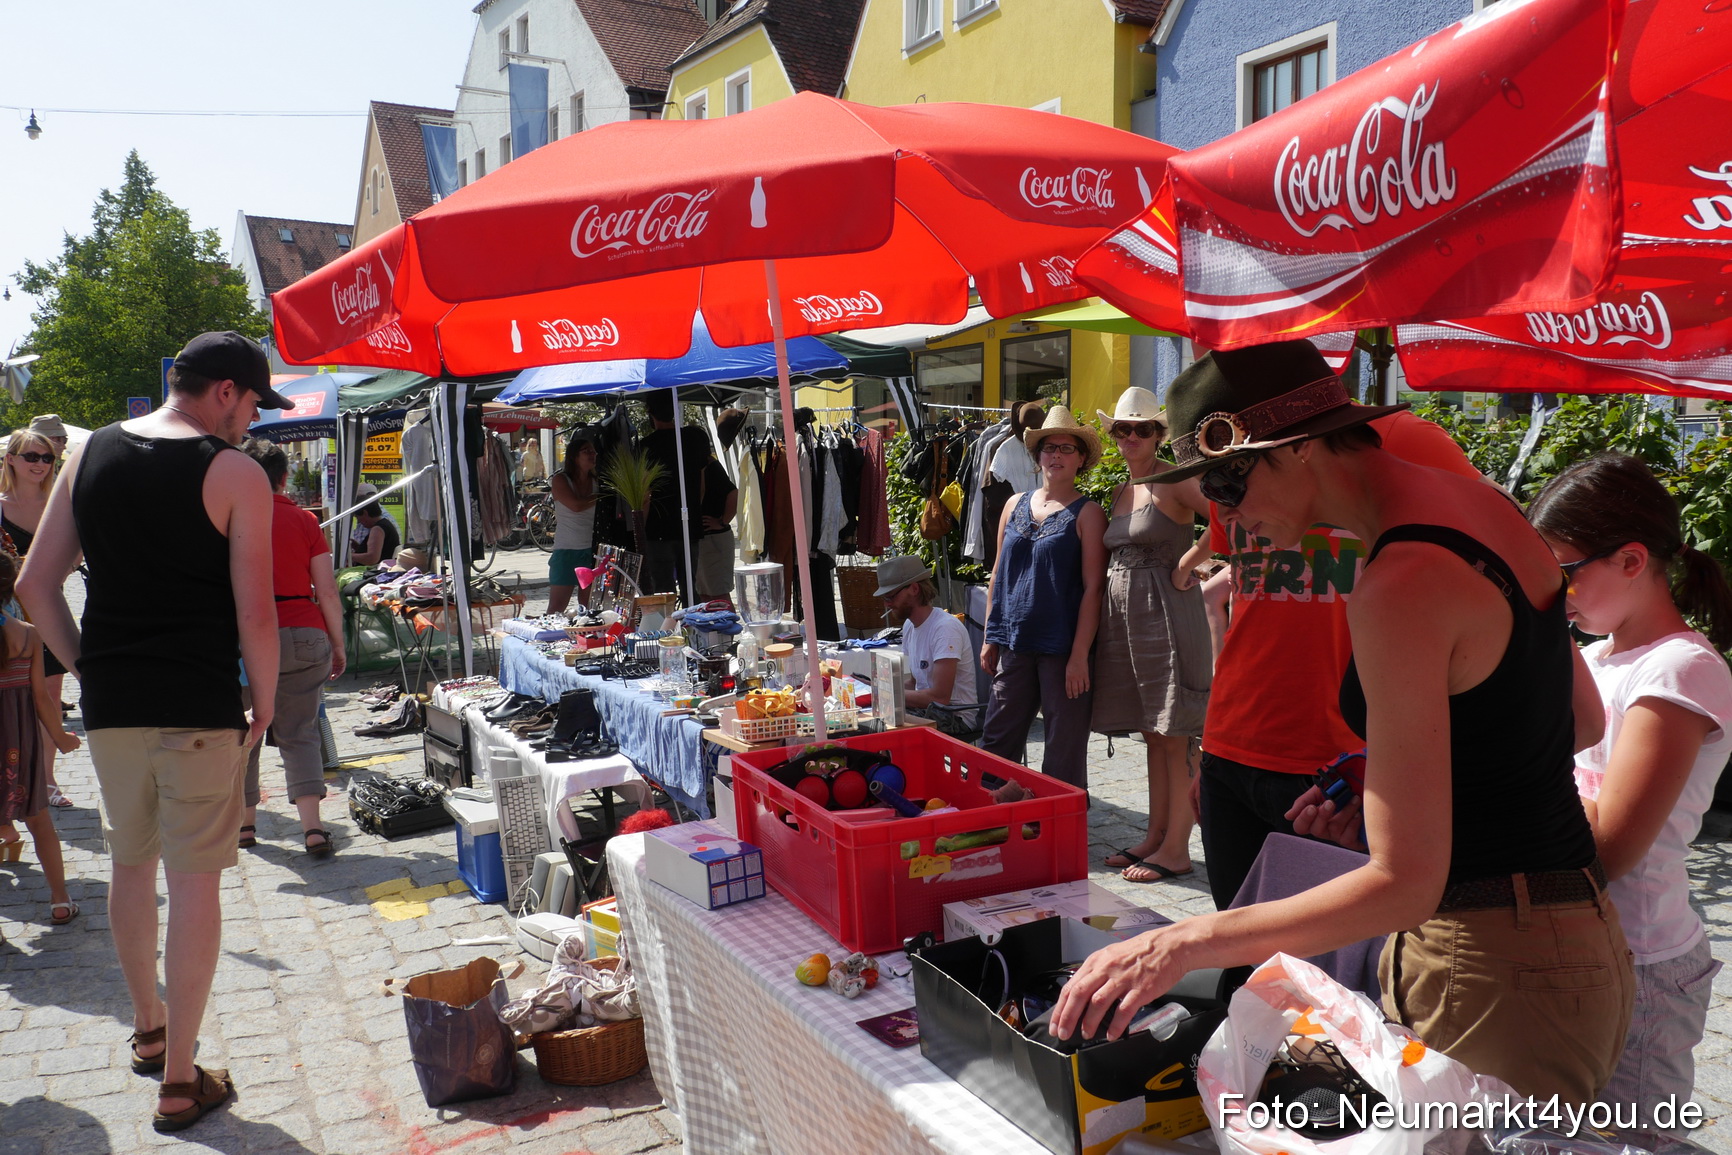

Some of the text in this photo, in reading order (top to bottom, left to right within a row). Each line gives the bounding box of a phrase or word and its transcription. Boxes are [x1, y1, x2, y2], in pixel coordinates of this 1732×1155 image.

[1274, 78, 1456, 237] Coca-Cola
[1019, 166, 1116, 209] Coca-Cola
[570, 188, 717, 259] Coca-Cola
[607, 248, 645, 262] Schutzmarken
[649, 241, 685, 254] koffeinhaltig
[499, 411, 542, 423] Lehmeier
